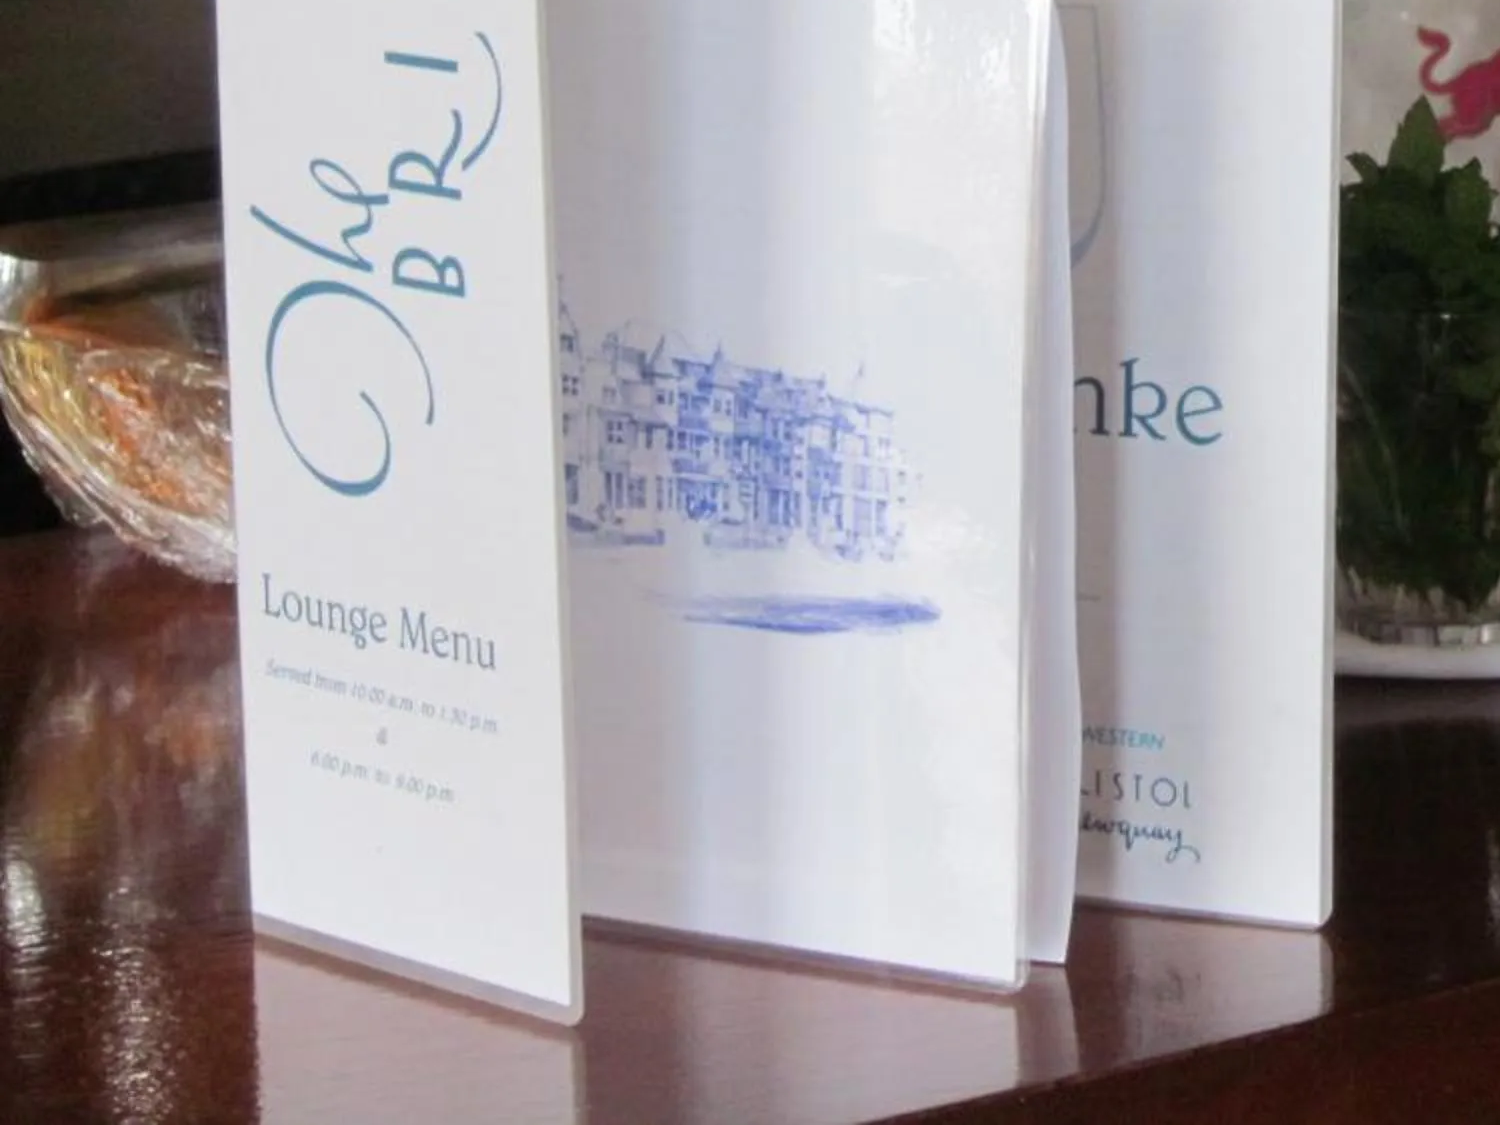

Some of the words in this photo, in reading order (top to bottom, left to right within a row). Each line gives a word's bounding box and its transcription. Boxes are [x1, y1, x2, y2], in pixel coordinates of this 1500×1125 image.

[1074, 357, 1223, 446] nke
[262, 573, 387, 650] Lounge
[400, 607, 496, 671] Menu
[264, 658, 312, 686] Served
[314, 673, 347, 696] from
[1081, 768, 1192, 809] ISTOL
